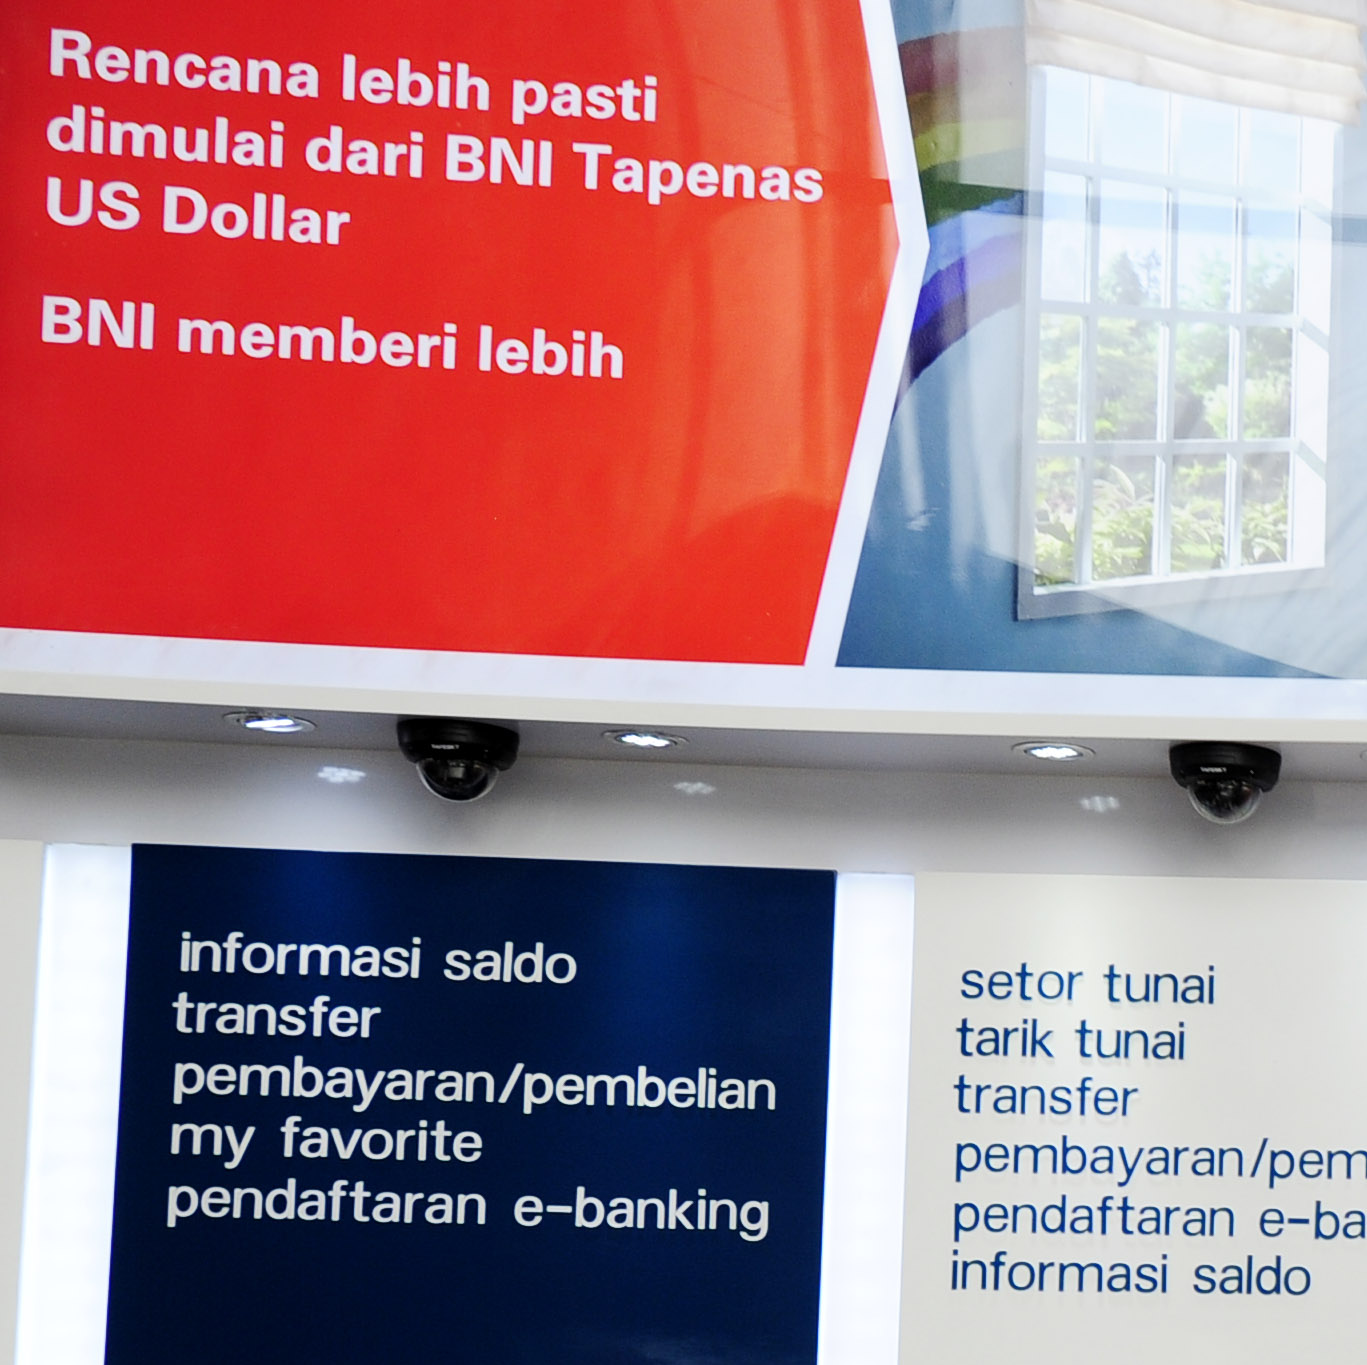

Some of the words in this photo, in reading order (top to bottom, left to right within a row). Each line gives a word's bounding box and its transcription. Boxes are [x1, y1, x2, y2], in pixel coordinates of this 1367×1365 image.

[50, 28, 318, 98] Rencana
[343, 54, 489, 110] lebih
[512, 75, 657, 125] pasti
[47, 104, 284, 168] dimulai
[305, 127, 423, 178] dari
[446, 134, 552, 187] BNI
[573, 142, 823, 205] Tapenas
[47, 176, 140, 230] US
[163, 186, 350, 245] Dollar
[42, 295, 154, 349] BNI
[178, 316, 457, 369] memberi
[479, 325, 623, 378] lebih
[181, 932, 421, 978] informasi
[444, 941, 577, 983] saldo
[961, 963, 1083, 1000] setor
[1104, 965, 1214, 1004] tunai
[172, 992, 381, 1038] transfer
[956, 1018, 1053, 1057] tarik
[1075, 1020, 1184, 1060] tunai
[173, 1055, 775, 1114] pembayaran/pembelian
[954, 1075, 1138, 1116] transfer
[171, 1123, 256, 1169] my
[280, 1116, 482, 1162] favorite
[167, 1178, 486, 1227] pendaftaran
[514, 1186, 769, 1241] e-banking
[954, 1195, 1234, 1242] pendaftaran
[952, 1249, 1167, 1293] informasi
[1193, 1255, 1310, 1295] saldo
